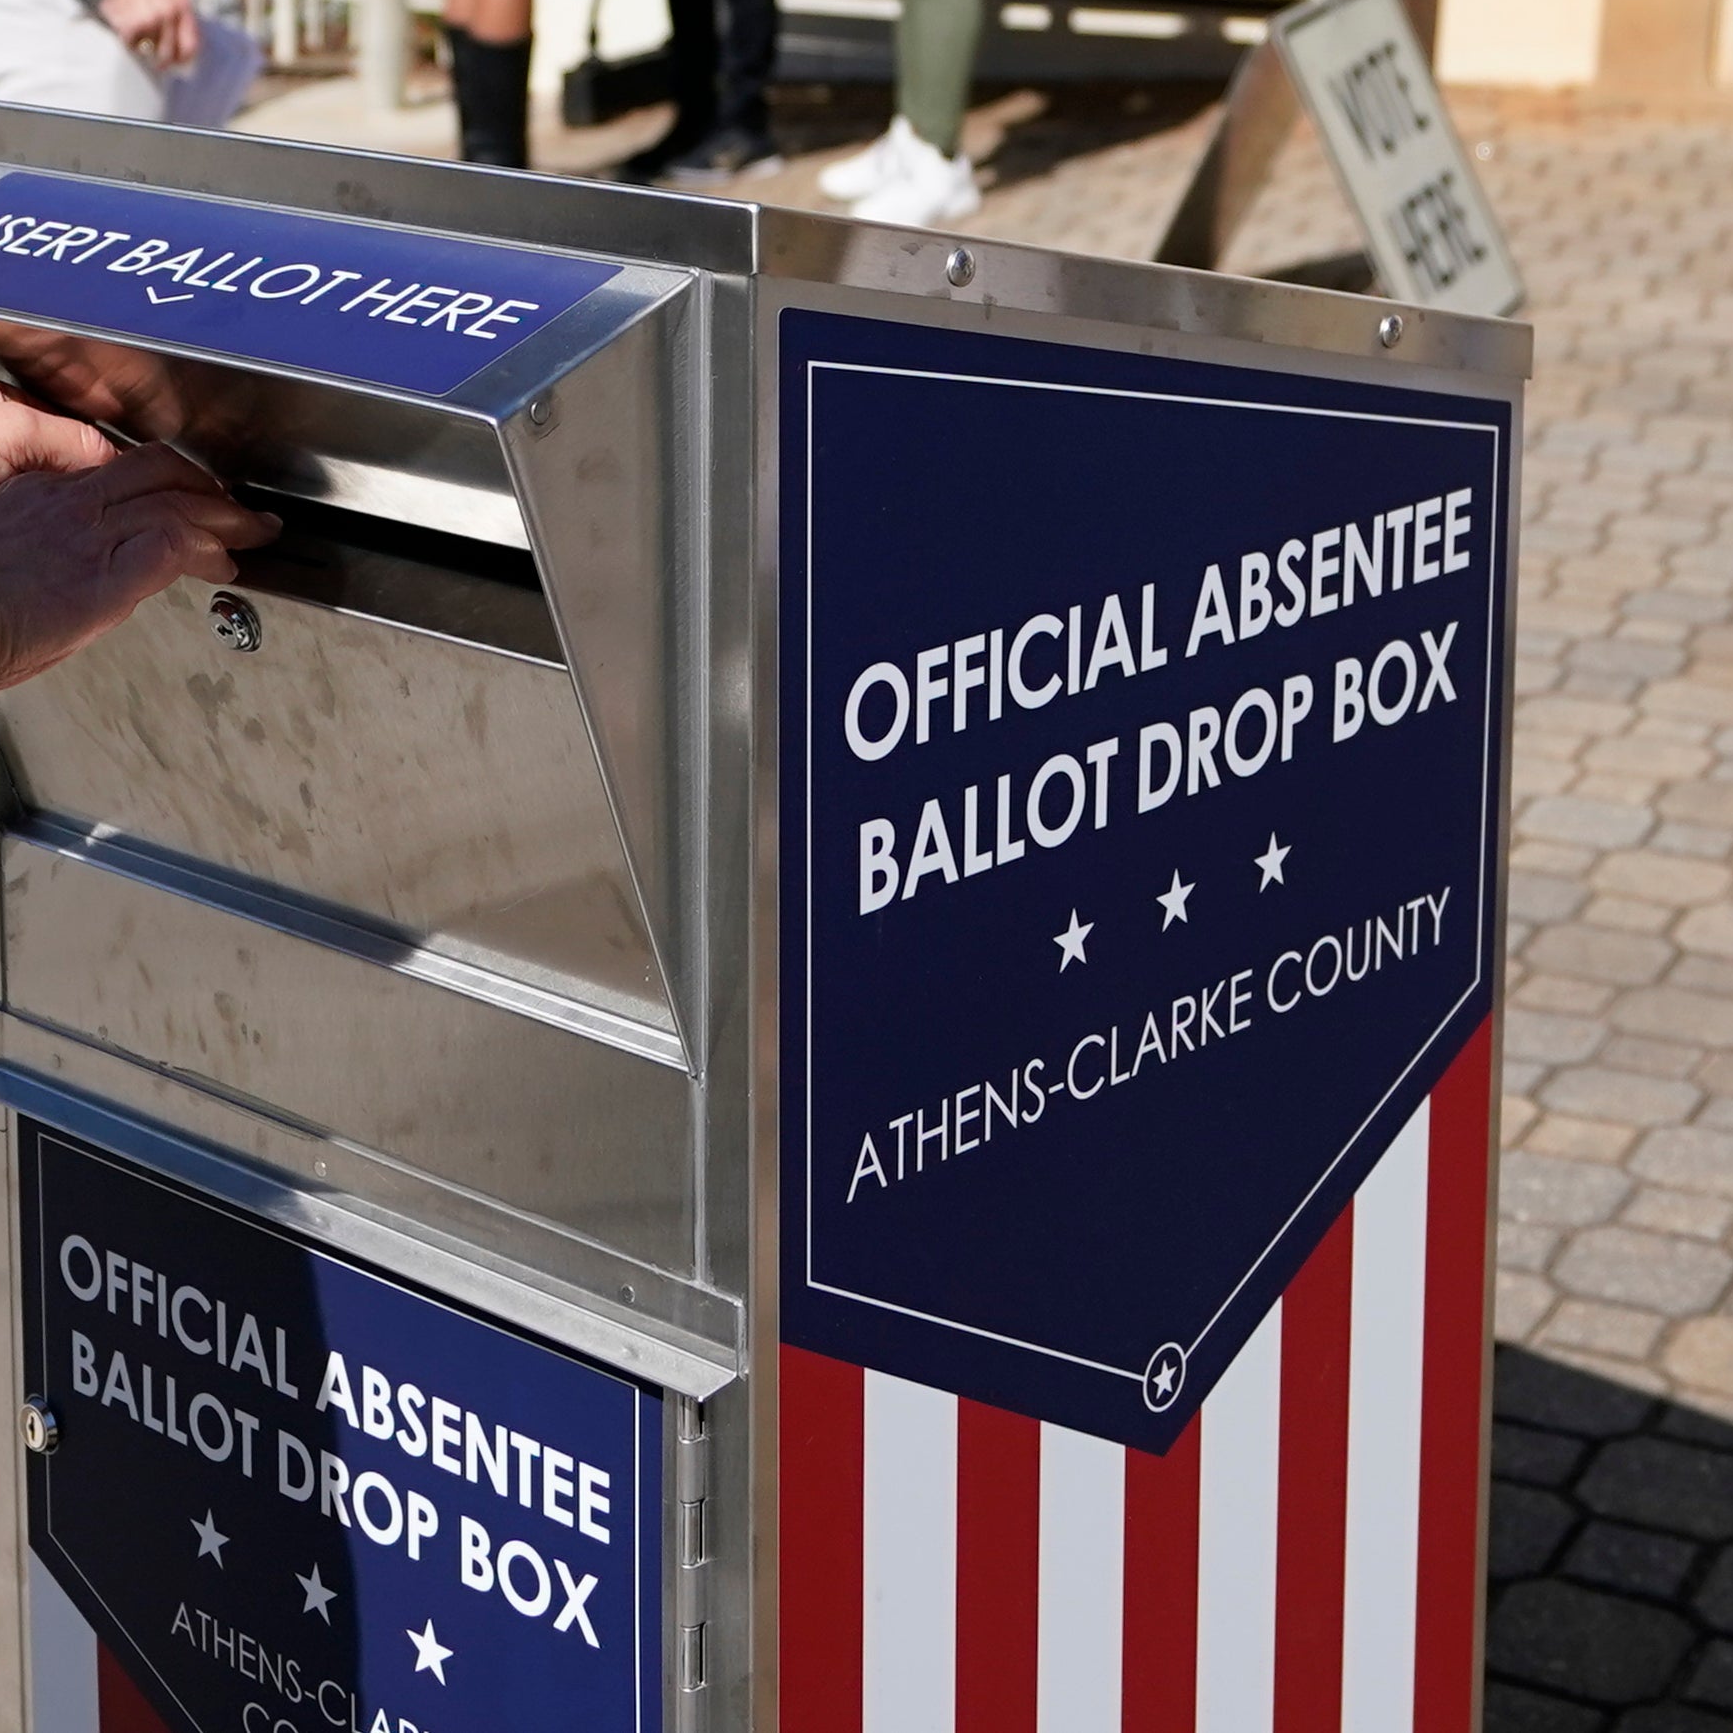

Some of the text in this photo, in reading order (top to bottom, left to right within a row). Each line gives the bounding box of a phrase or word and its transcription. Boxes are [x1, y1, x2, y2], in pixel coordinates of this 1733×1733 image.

[107, 238, 362, 306] BALLOT
[341, 277, 539, 340] HERE
[844, 487, 1472, 760] OFFICIAL ABSENTEE
[859, 621, 1460, 916] BALLOT DROP BOX
[846, 885, 1451, 1204] ATHENS-CLARKE COUNTY
[60, 1234, 611, 1545] OFFICIAL ABSENTEE
[71, 1329, 601, 1650] BALLOT DROP BOX
[171, 1602, 429, 1733] ATHENS-CLA
